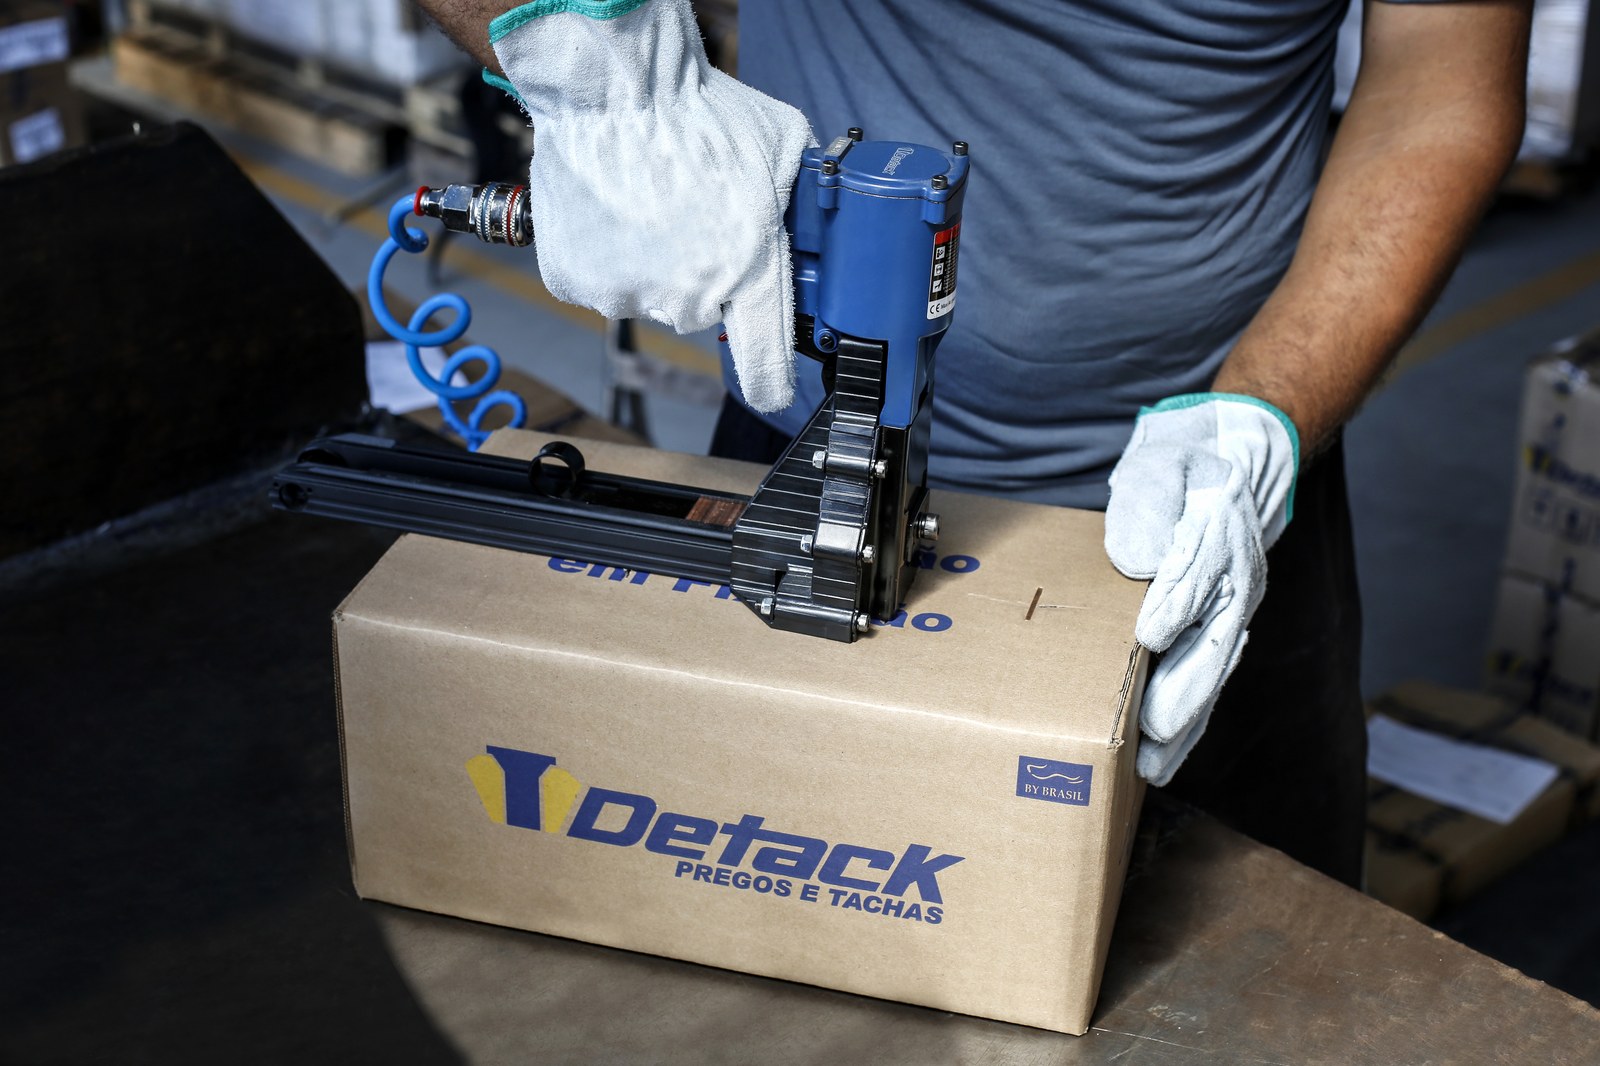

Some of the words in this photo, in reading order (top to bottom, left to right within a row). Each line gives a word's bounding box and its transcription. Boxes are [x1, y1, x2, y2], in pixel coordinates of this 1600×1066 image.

[1025, 783, 1040, 795] BY
[1042, 786, 1084, 801] BRASIL
[567, 787, 965, 905] Detack
[675, 861, 792, 897] PREGOS
[799, 883, 820, 903] E
[829, 888, 944, 926] TACHAS
